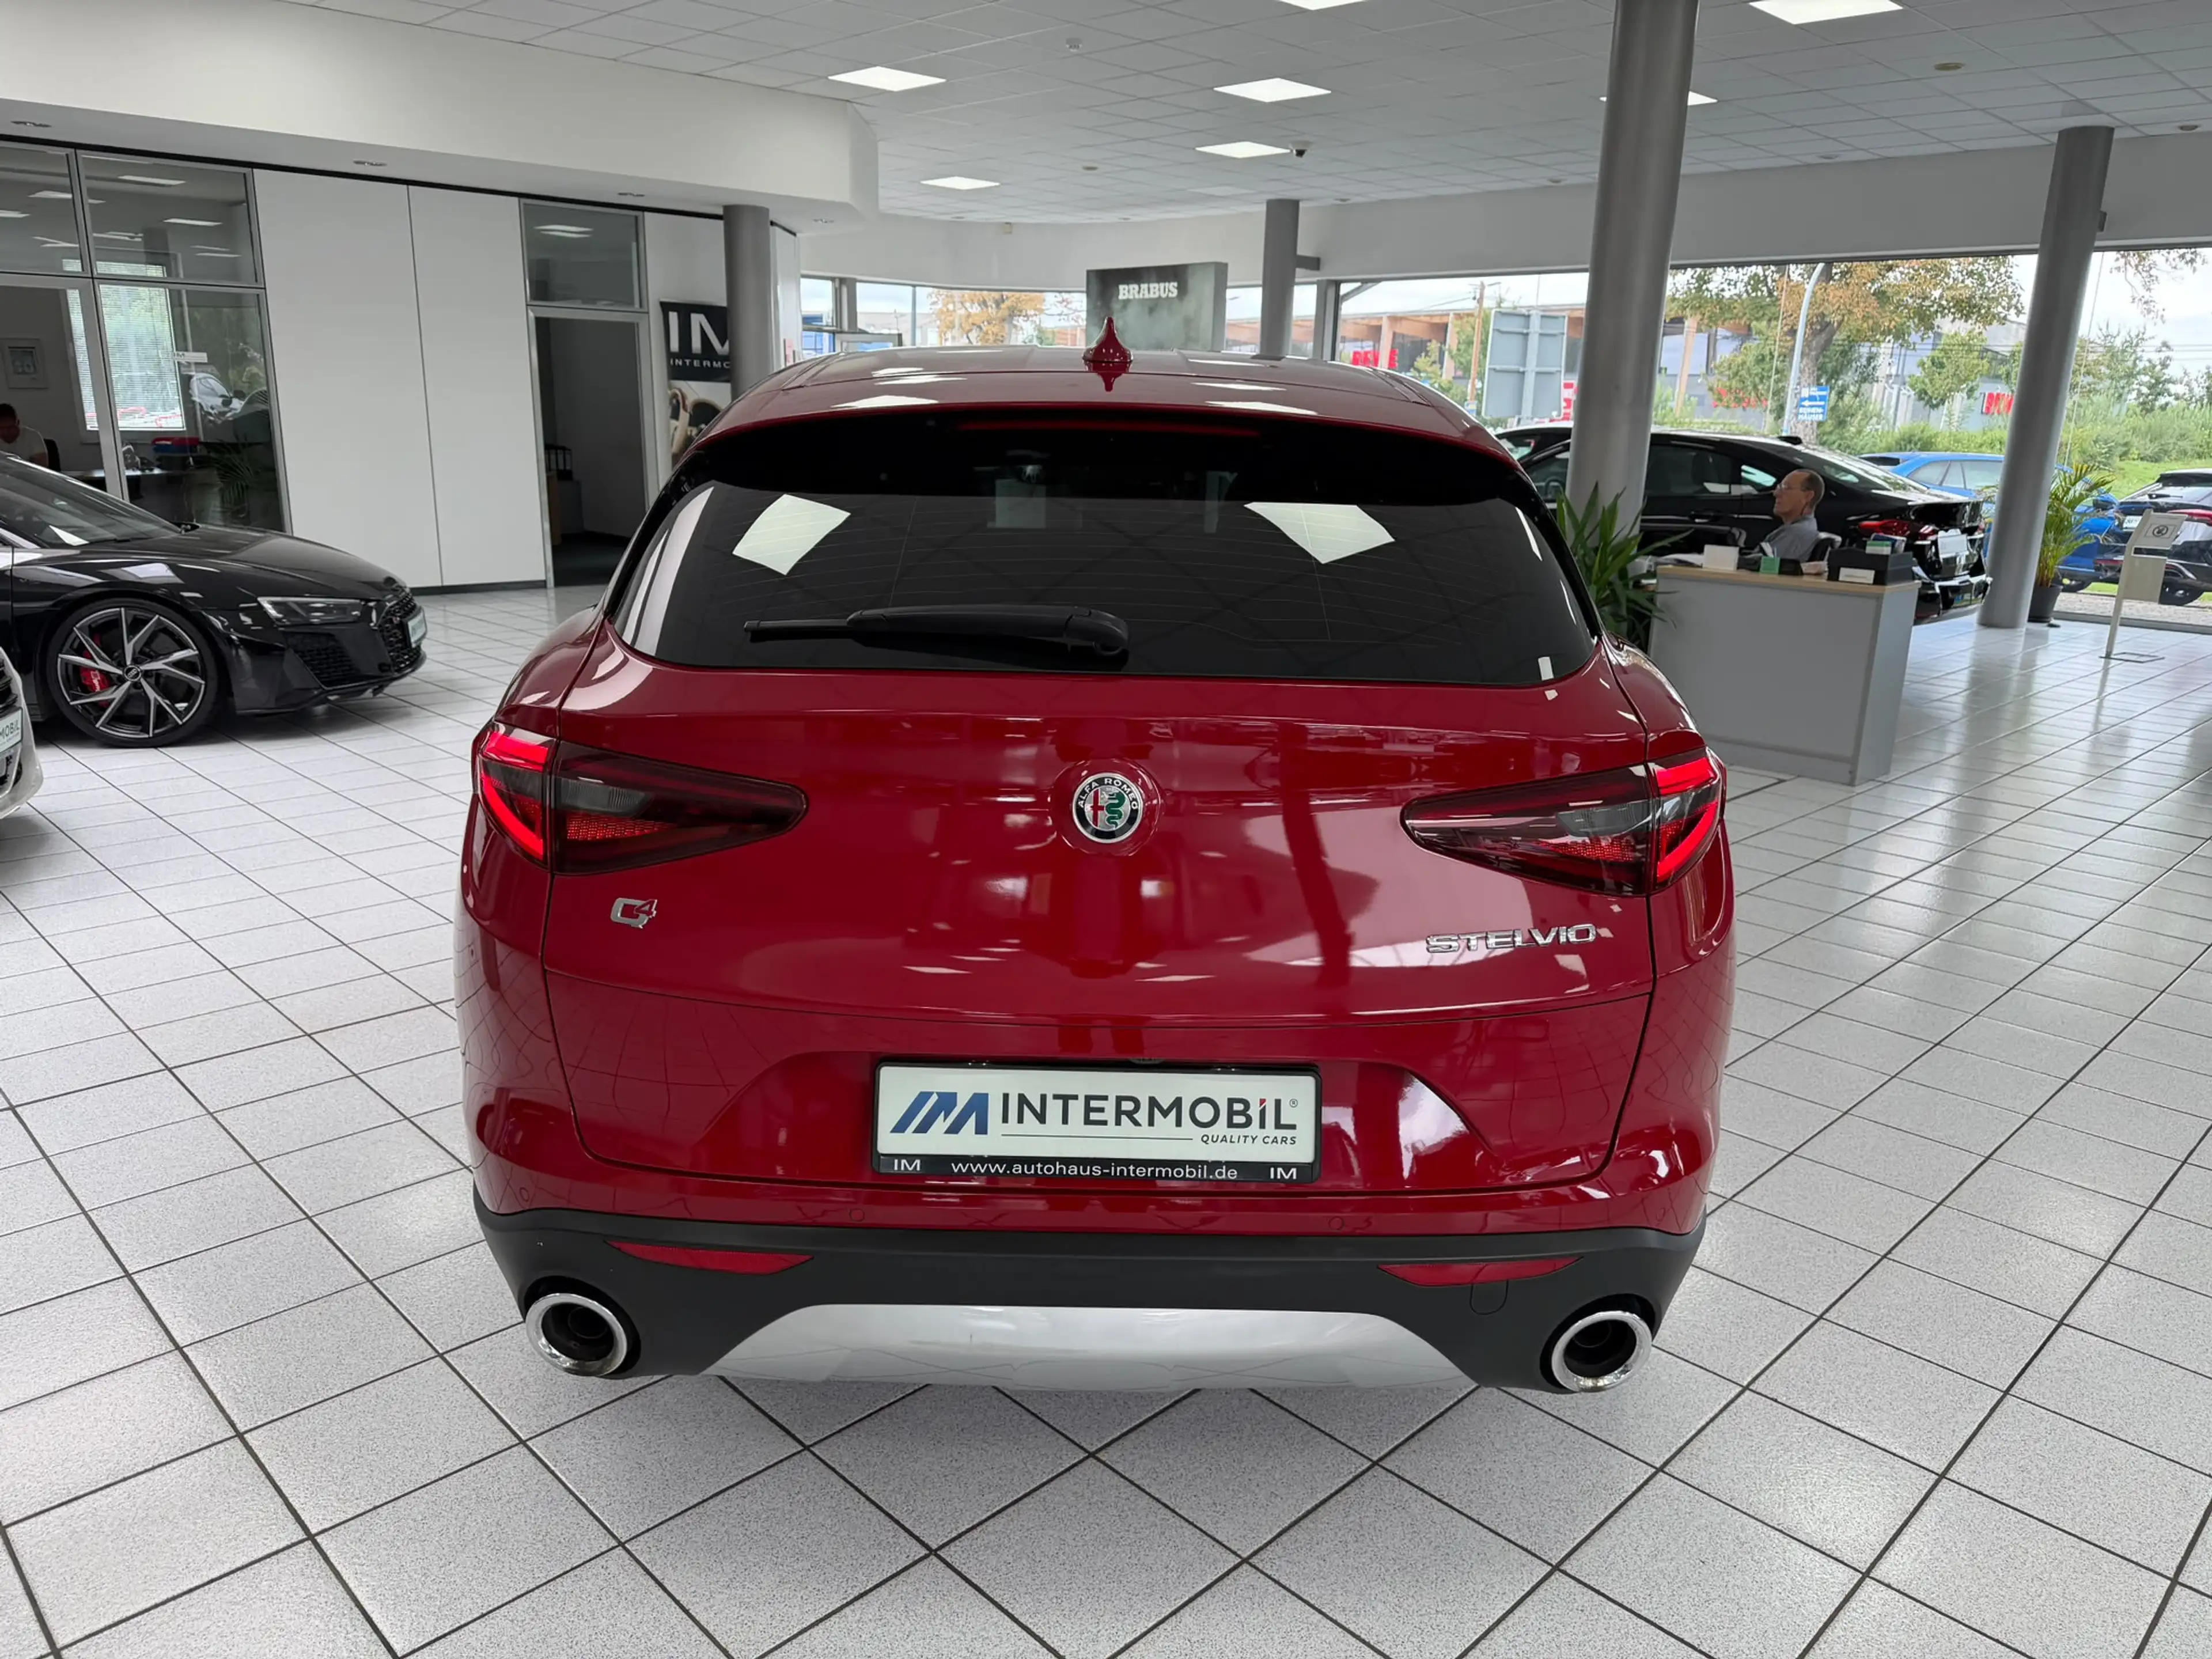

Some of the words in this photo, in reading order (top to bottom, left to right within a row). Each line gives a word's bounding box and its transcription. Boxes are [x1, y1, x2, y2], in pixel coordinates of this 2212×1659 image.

[1118, 282, 1178, 300] BRABUS
[1078, 782, 1099, 808] ALFA
[1104, 778, 1138, 809] ROMEO
[1426, 923, 1596, 953] STELVIO
[1200, 1134, 1258, 1145] QUALITY
[1262, 1136, 1297, 1145] CARS
[893, 1158, 921, 1171] IM
[951, 1161, 1238, 1180] www.autohaus-intermobil.de
[1270, 1167, 1297, 1179] IM
